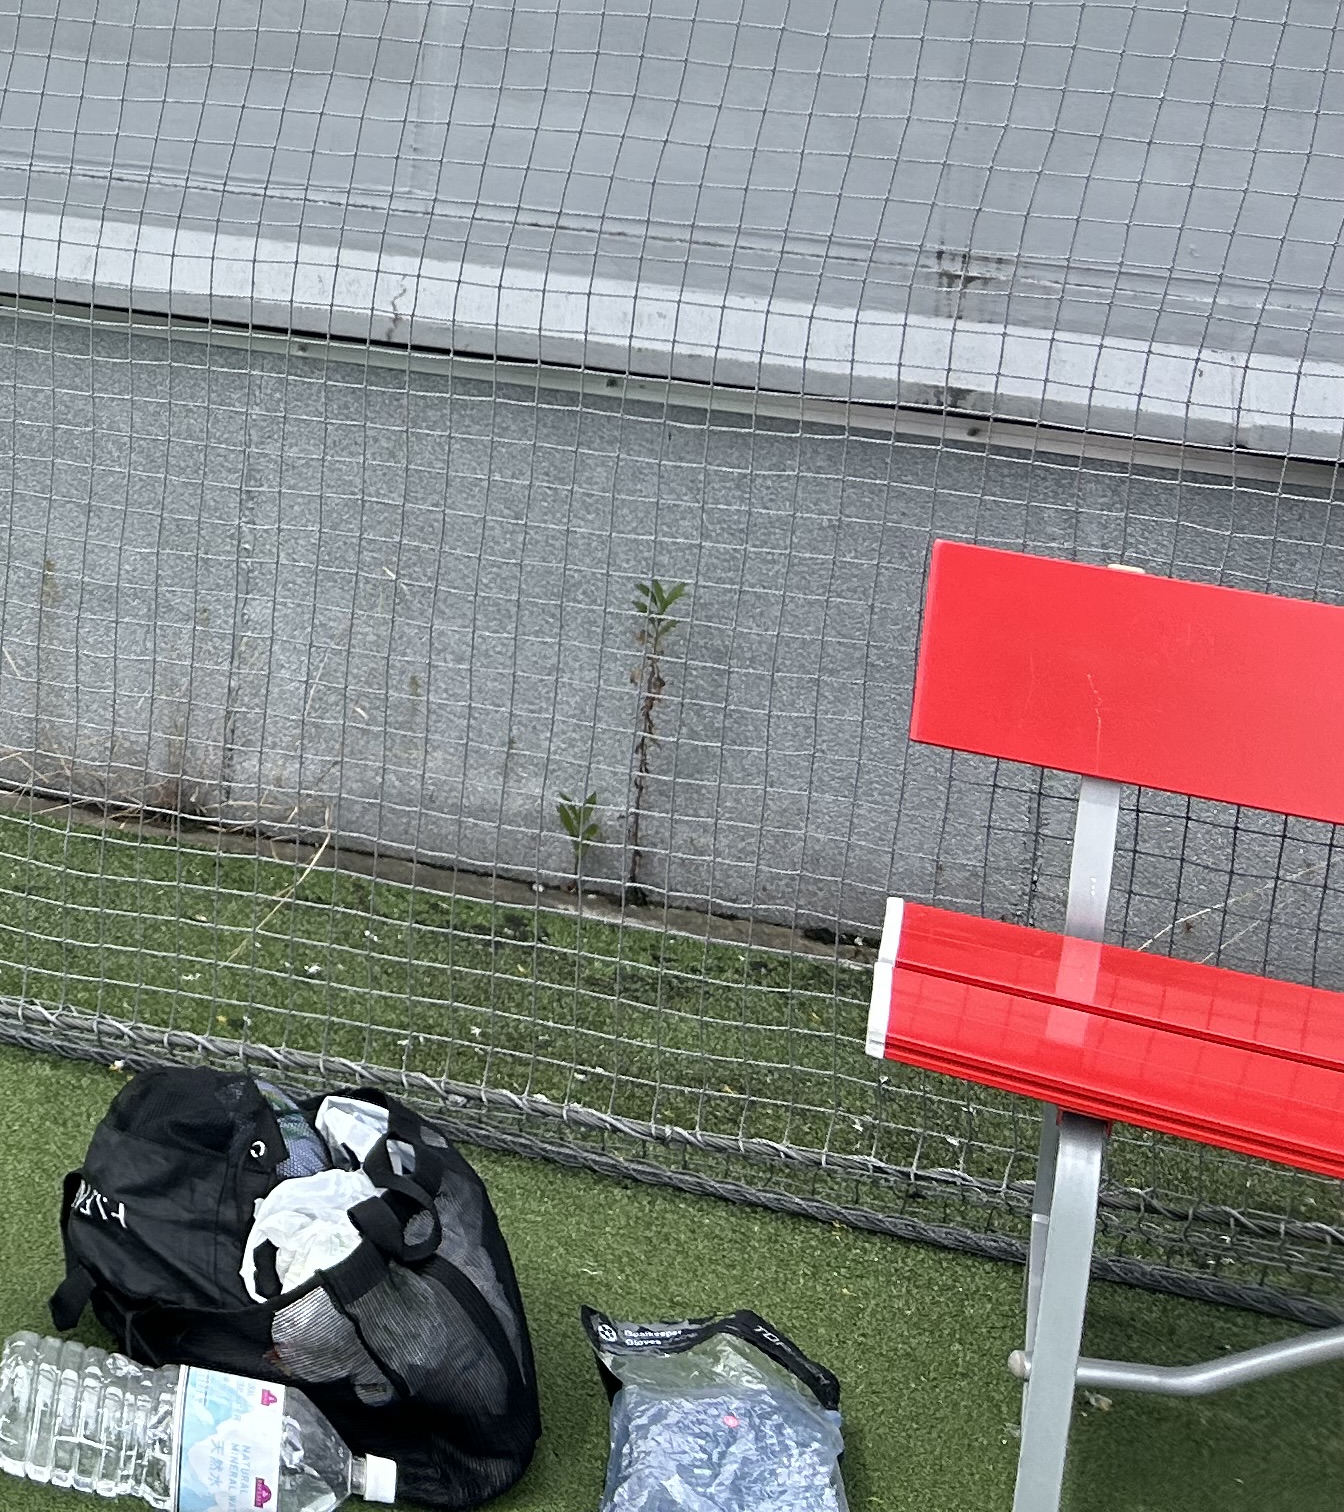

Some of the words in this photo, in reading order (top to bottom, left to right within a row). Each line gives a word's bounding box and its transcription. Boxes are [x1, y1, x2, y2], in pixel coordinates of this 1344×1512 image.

[208, 1438, 225, 1487] 天然水
[227, 1442, 241, 1491] MINERAL
[239, 1444, 252, 1494] NATURAL
